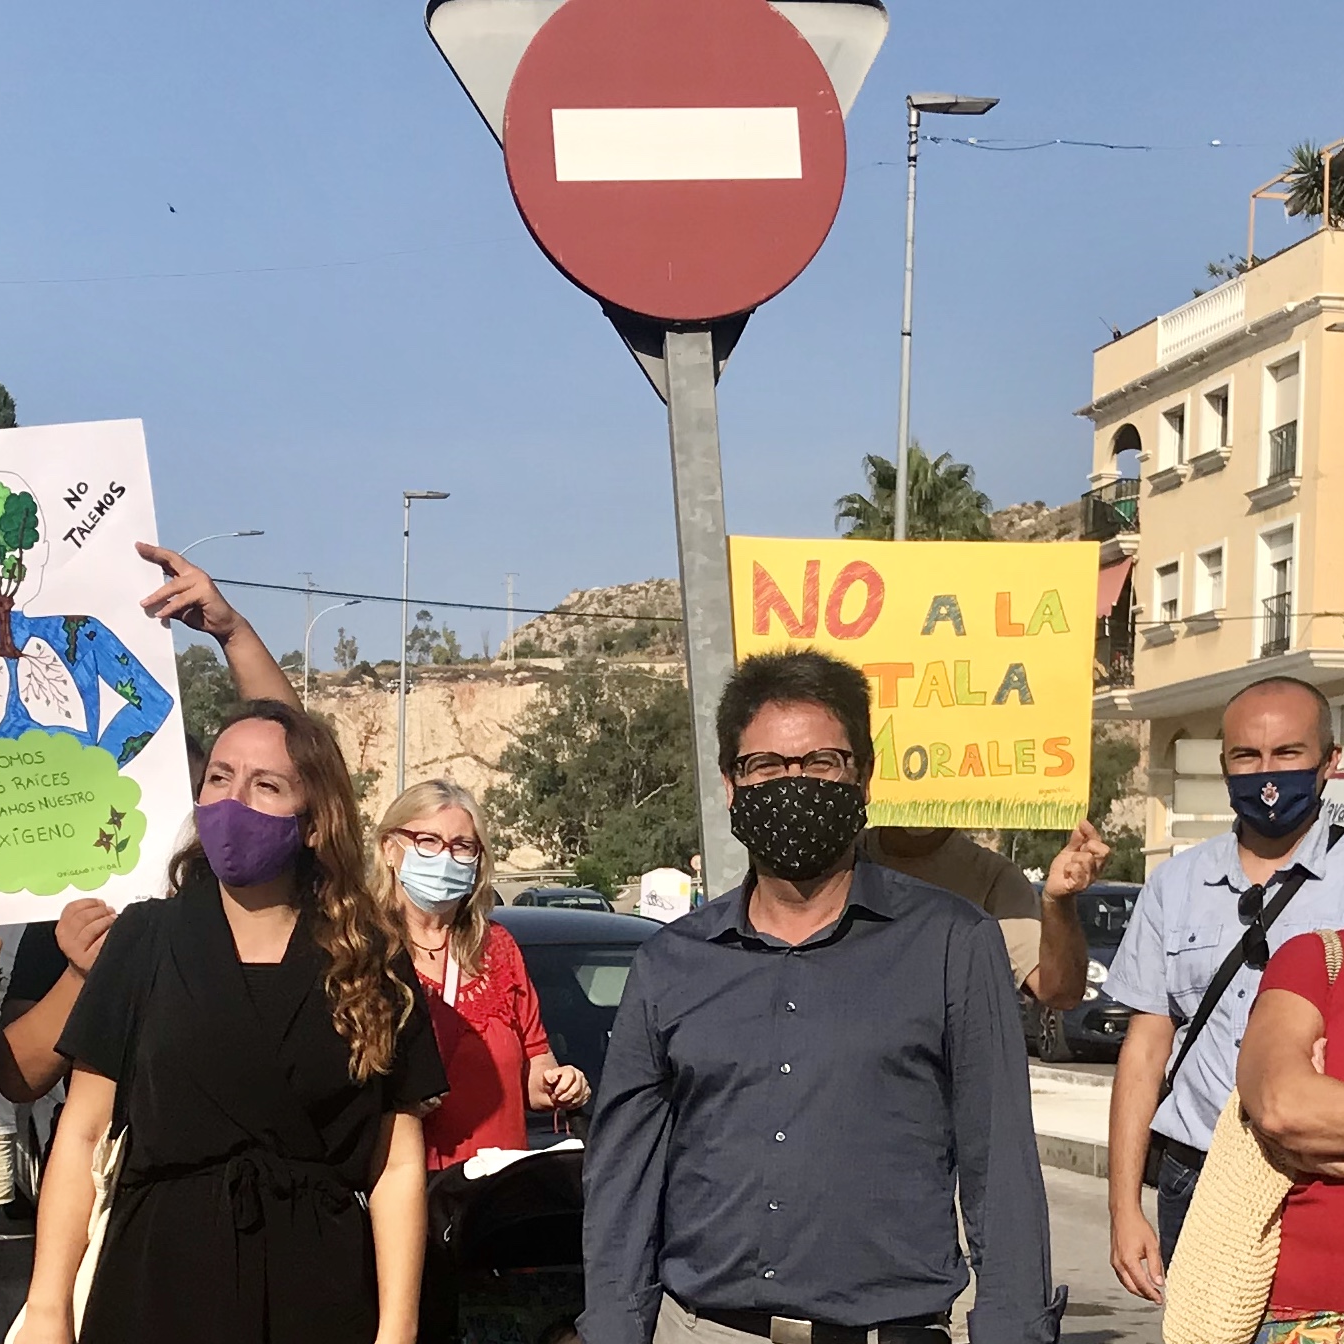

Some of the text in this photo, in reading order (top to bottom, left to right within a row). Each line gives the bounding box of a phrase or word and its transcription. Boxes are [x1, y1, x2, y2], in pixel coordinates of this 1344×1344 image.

[63, 481, 127, 549] TALEMOS
[66, 480, 90, 512] NO
[752, 559, 1070, 640] NO A LA
[862, 659, 1034, 709] TALA
[38, 791, 95, 811] NUESTRO
